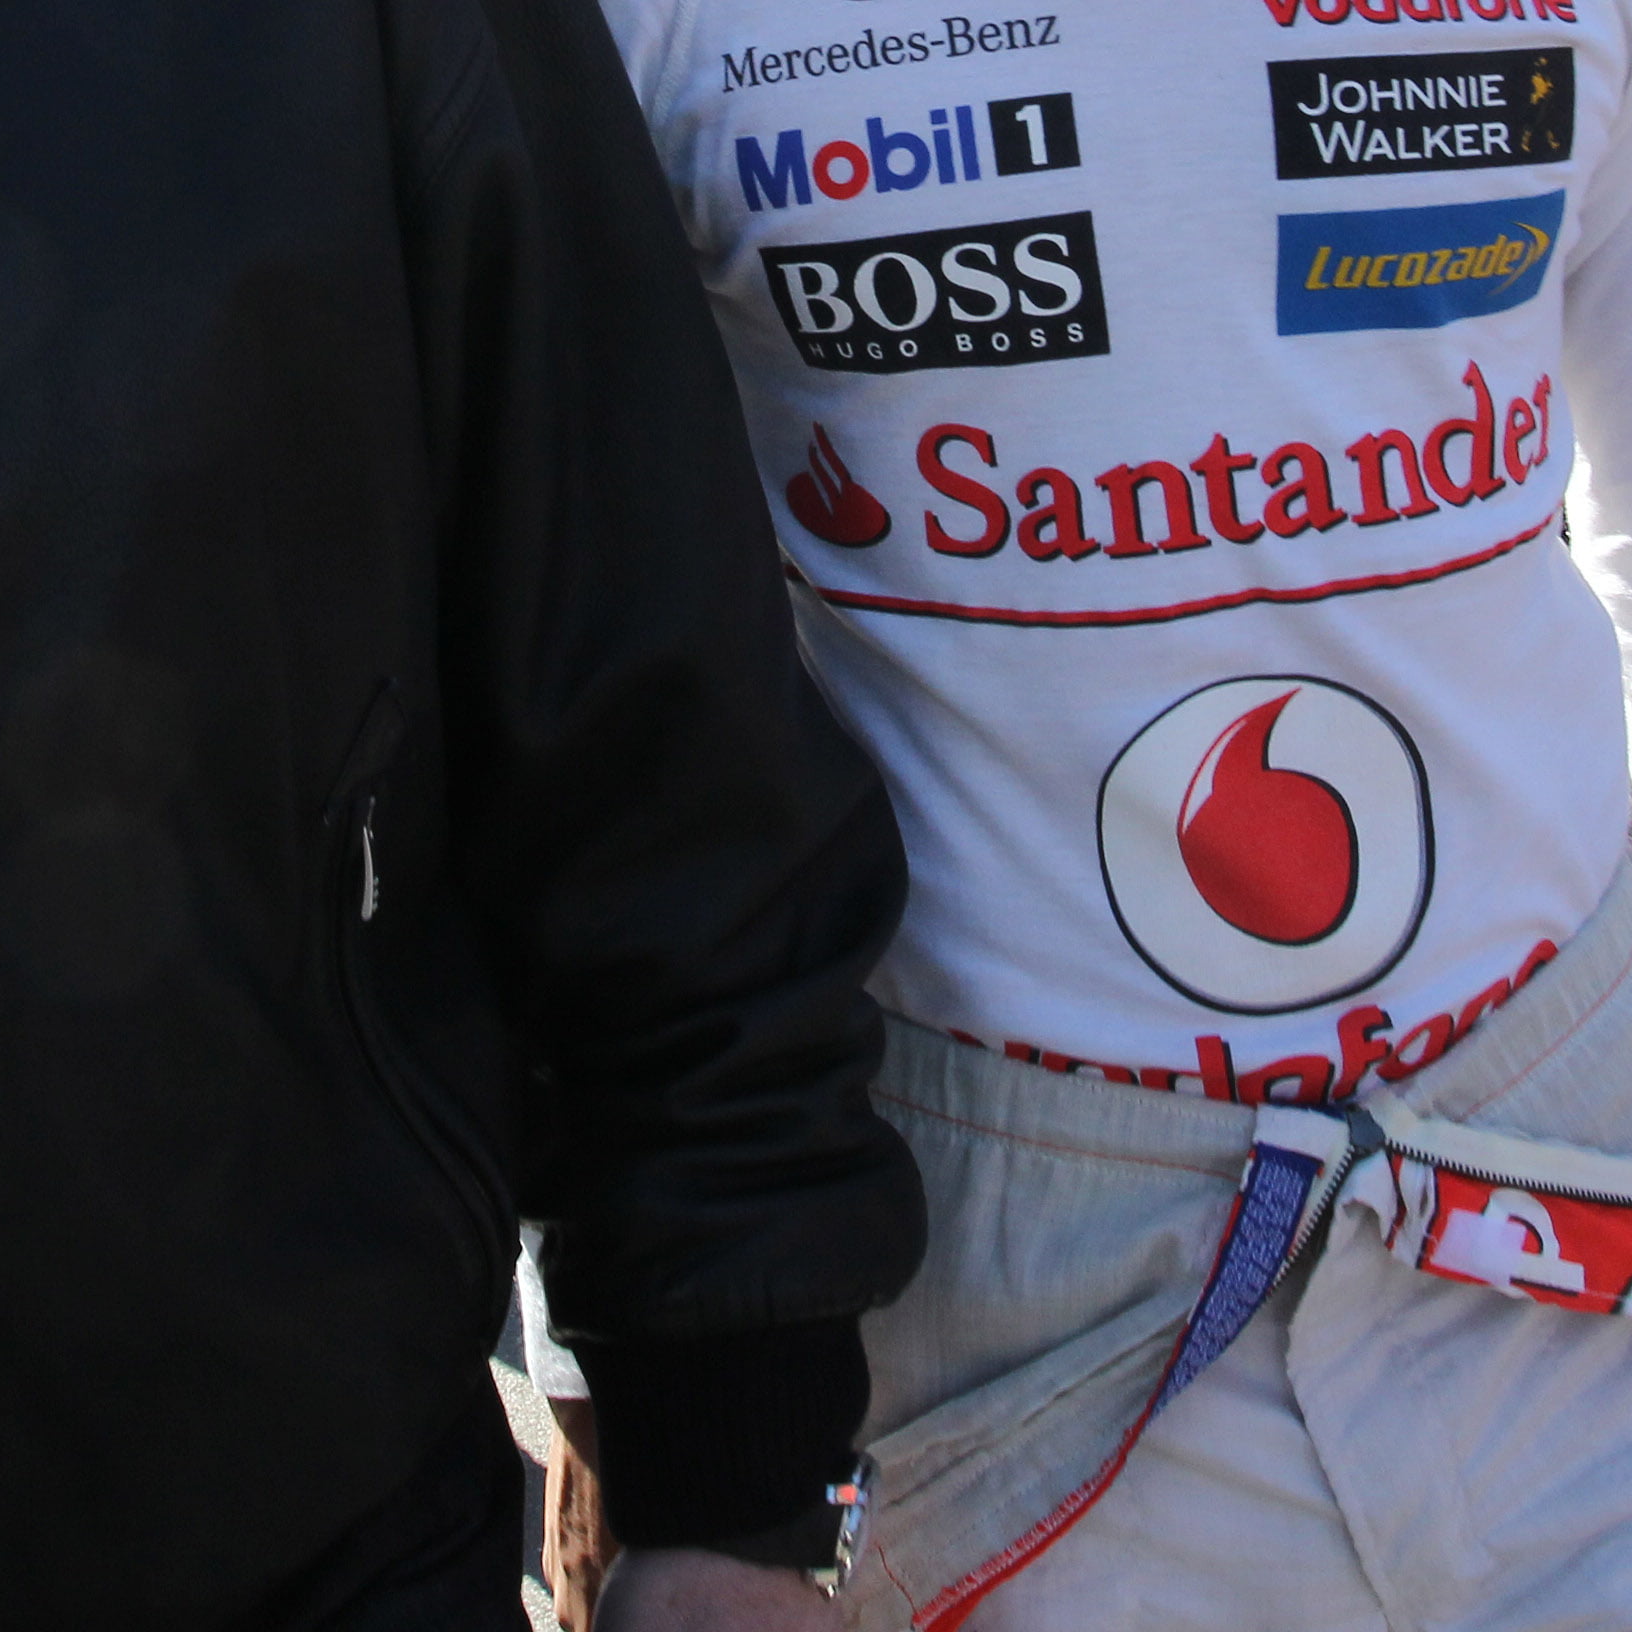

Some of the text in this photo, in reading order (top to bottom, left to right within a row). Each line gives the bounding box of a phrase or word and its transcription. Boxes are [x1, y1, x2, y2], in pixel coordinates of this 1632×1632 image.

[722, 15, 1061, 93] Mercedes-Benz
[1297, 72, 1507, 116] JOHNNIE
[735, 104, 1048, 212] Mobil 1
[1309, 119, 1512, 164] WALKER
[776, 232, 1083, 334] BOSS
[1304, 234, 1526, 291] Lucozade
[810, 322, 1085, 360] HUGO BOSS
[915, 359, 1552, 563] Santander
